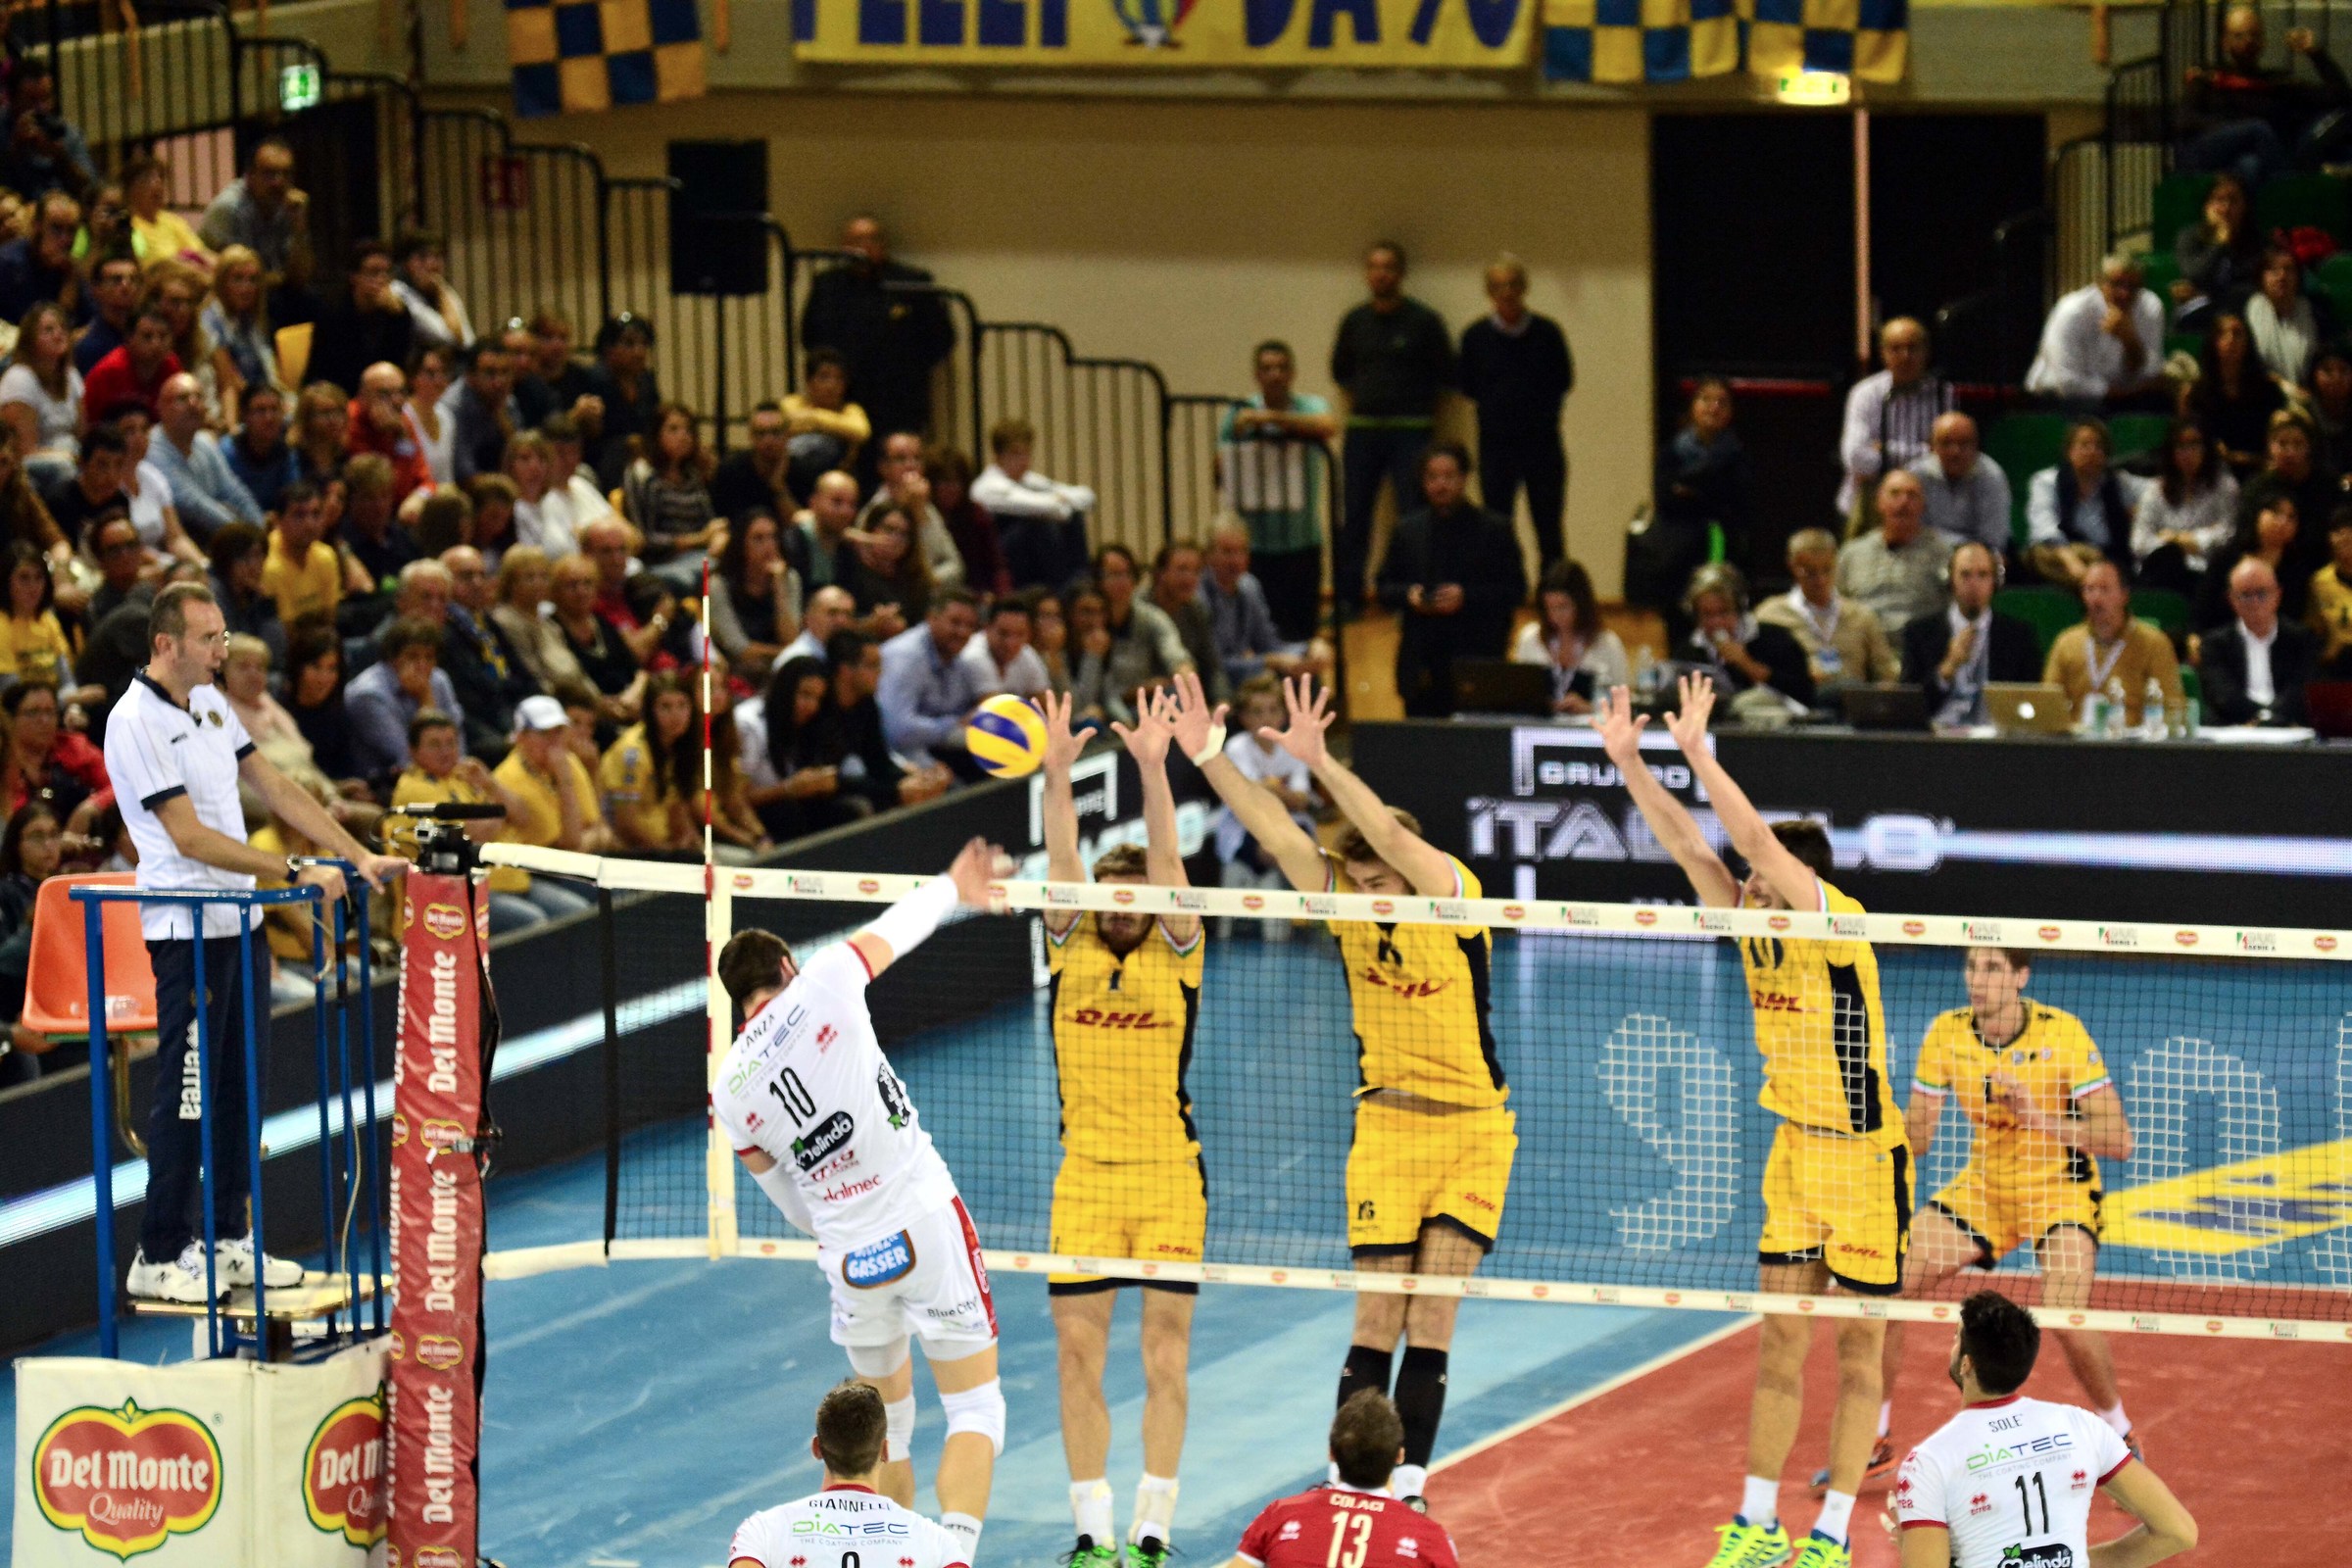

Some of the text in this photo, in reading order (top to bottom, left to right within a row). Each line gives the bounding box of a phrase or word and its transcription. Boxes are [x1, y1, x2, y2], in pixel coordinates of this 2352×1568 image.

[1538, 760, 1690, 789] GRUPO
[428, 950, 457, 1094] Del Monte
[1076, 1008, 1158, 1029] DHL
[769, 1066, 817, 1128] 10
[796, 1117, 854, 1167] Melinda
[425, 1169, 457, 1312] Del Monte
[848, 1246, 909, 1278] GASSER
[927, 1296, 979, 1318] Blue City
[423, 1383, 454, 1475] Monte
[49, 1447, 210, 1493] Del Monte
[319, 1447, 361, 1490] Del
[1979, 1453, 2073, 1481] THE COATING COMPANY
[88, 1492, 165, 1527] Quality
[421, 1477, 455, 1525] Del
[808, 1496, 892, 1514] GIANNELLI
[1329, 1494, 1385, 1513] COLACI
[2015, 1472, 2049, 1538] 11
[818, 1538, 858, 1547] COATING
[860, 1538, 904, 1546] COMPANY
[1326, 1510, 1374, 1568] 13
